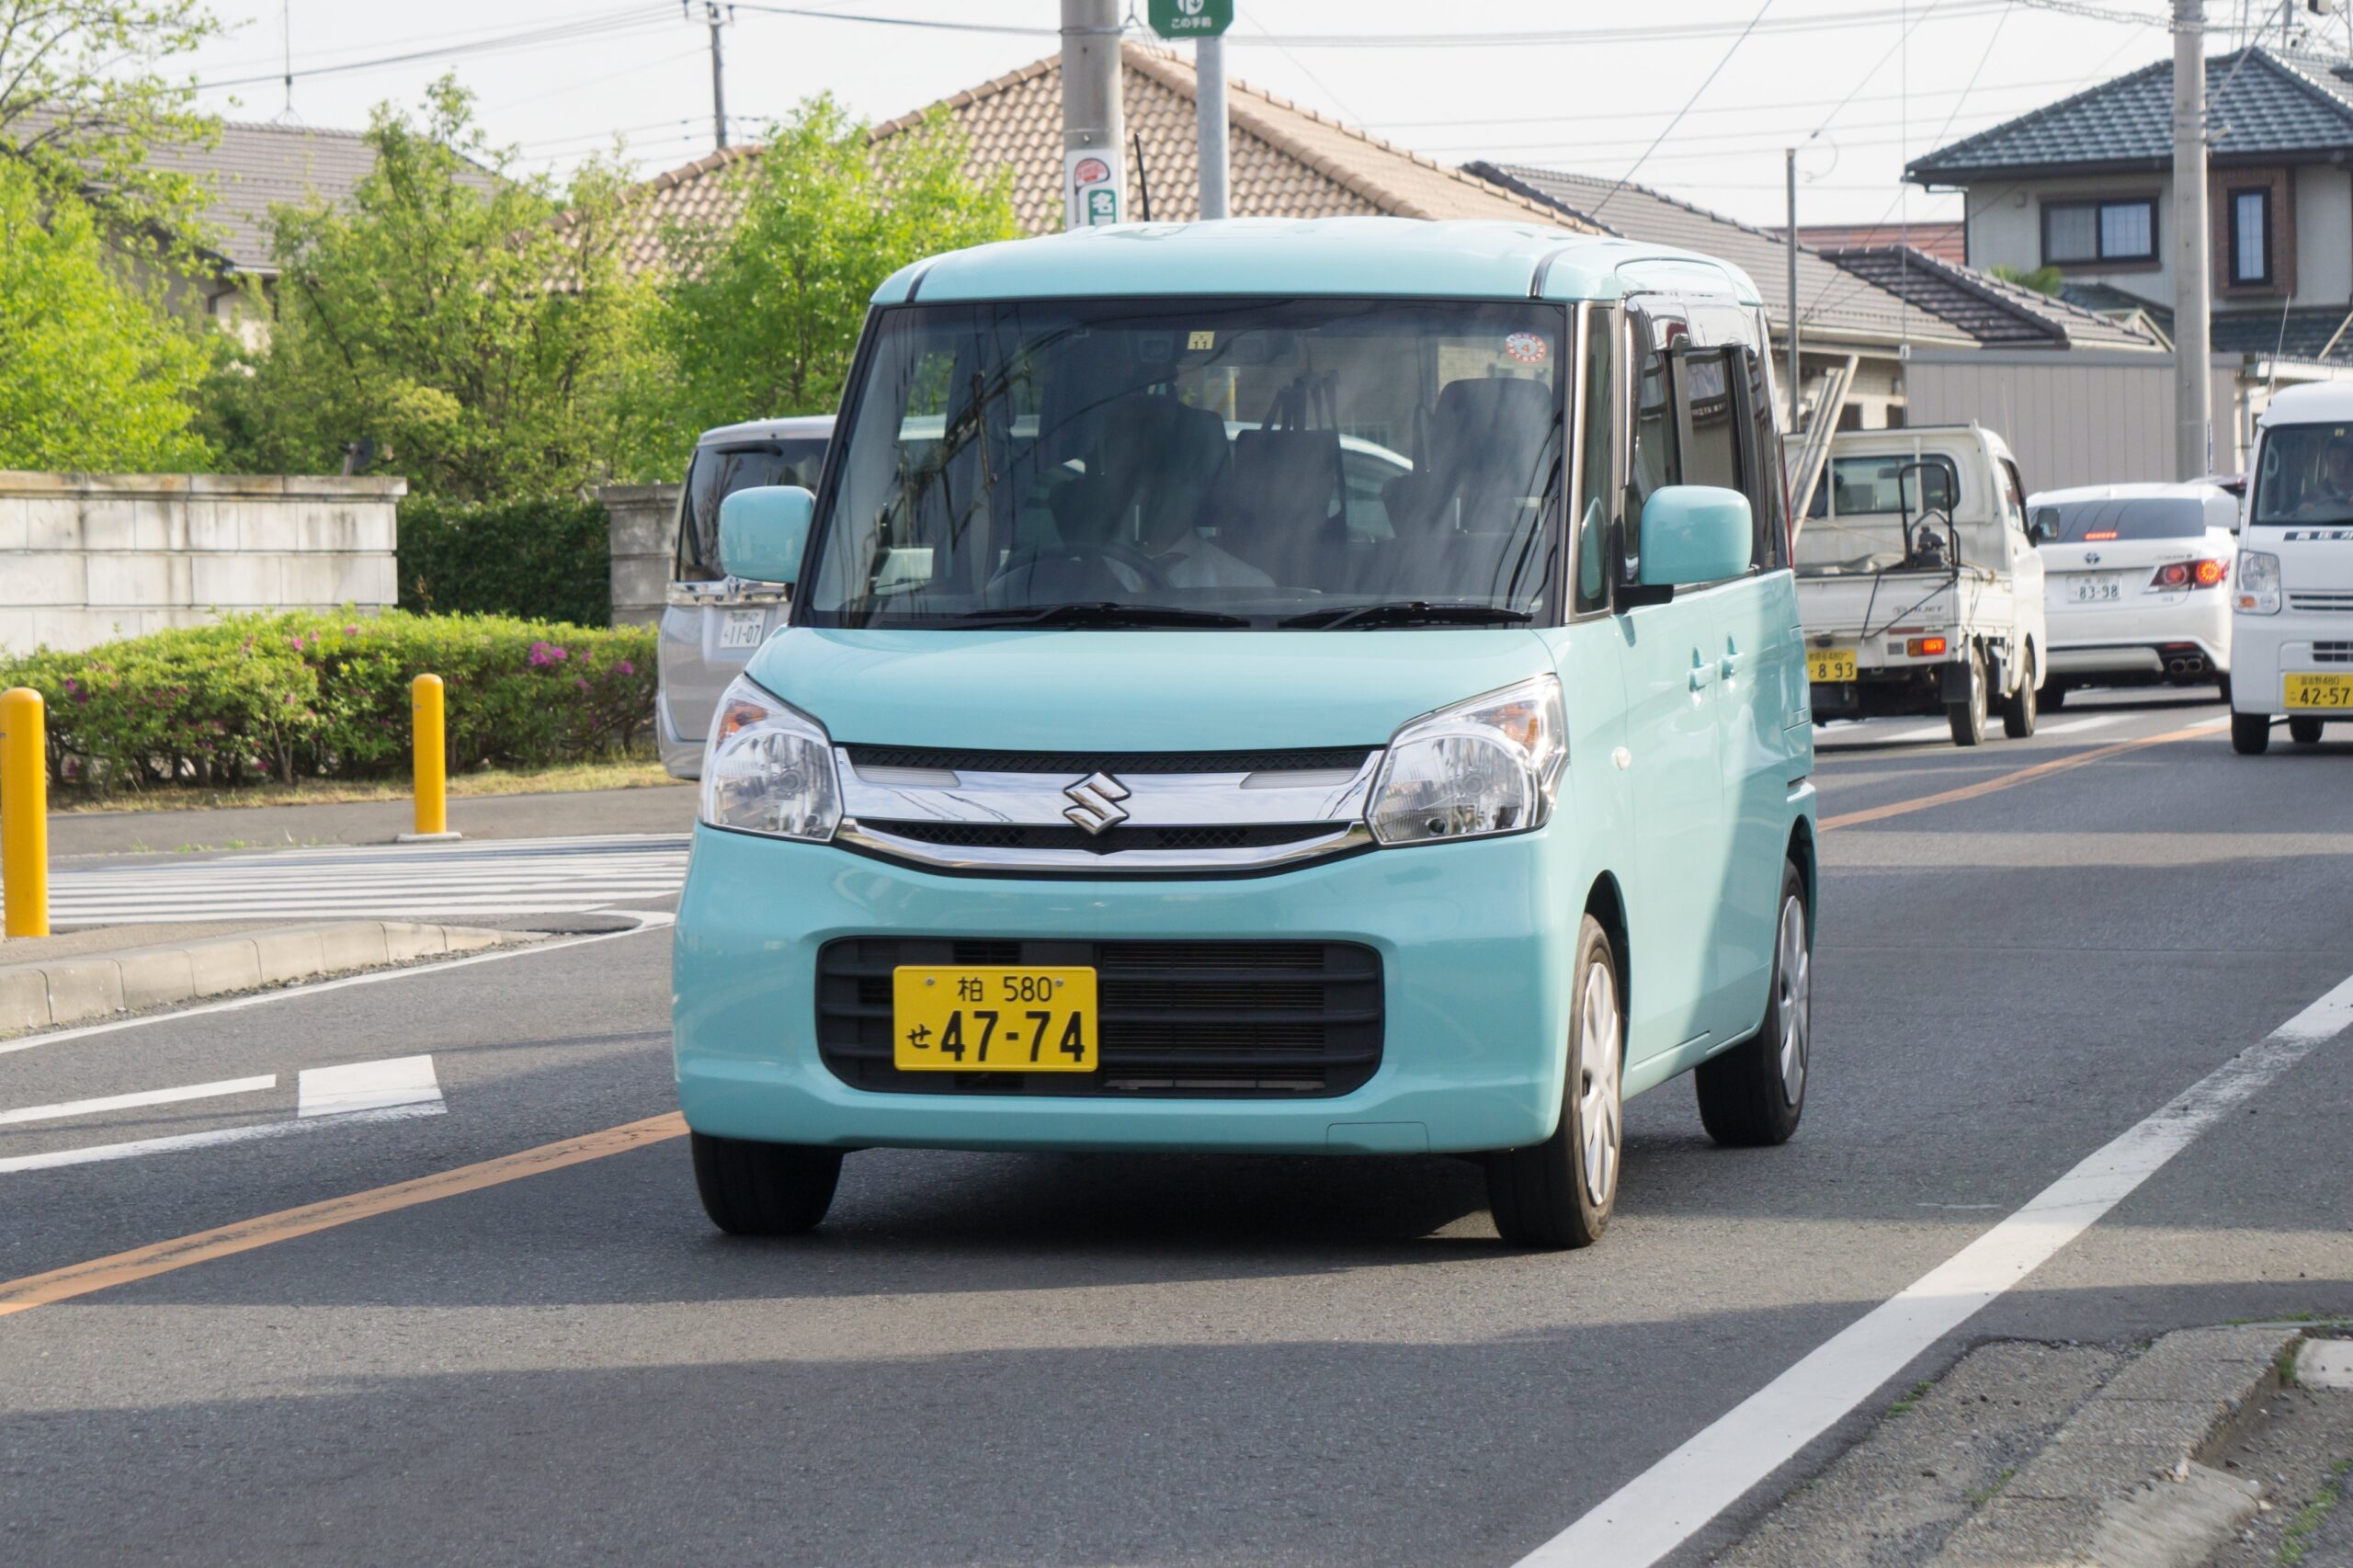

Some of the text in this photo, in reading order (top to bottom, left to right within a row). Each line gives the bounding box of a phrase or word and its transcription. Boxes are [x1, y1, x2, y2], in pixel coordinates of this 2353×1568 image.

[2300, 687, 2351, 705] 42-57
[957, 976, 1052, 1002] 柏 580
[906, 1010, 1086, 1062] せ 47-74
